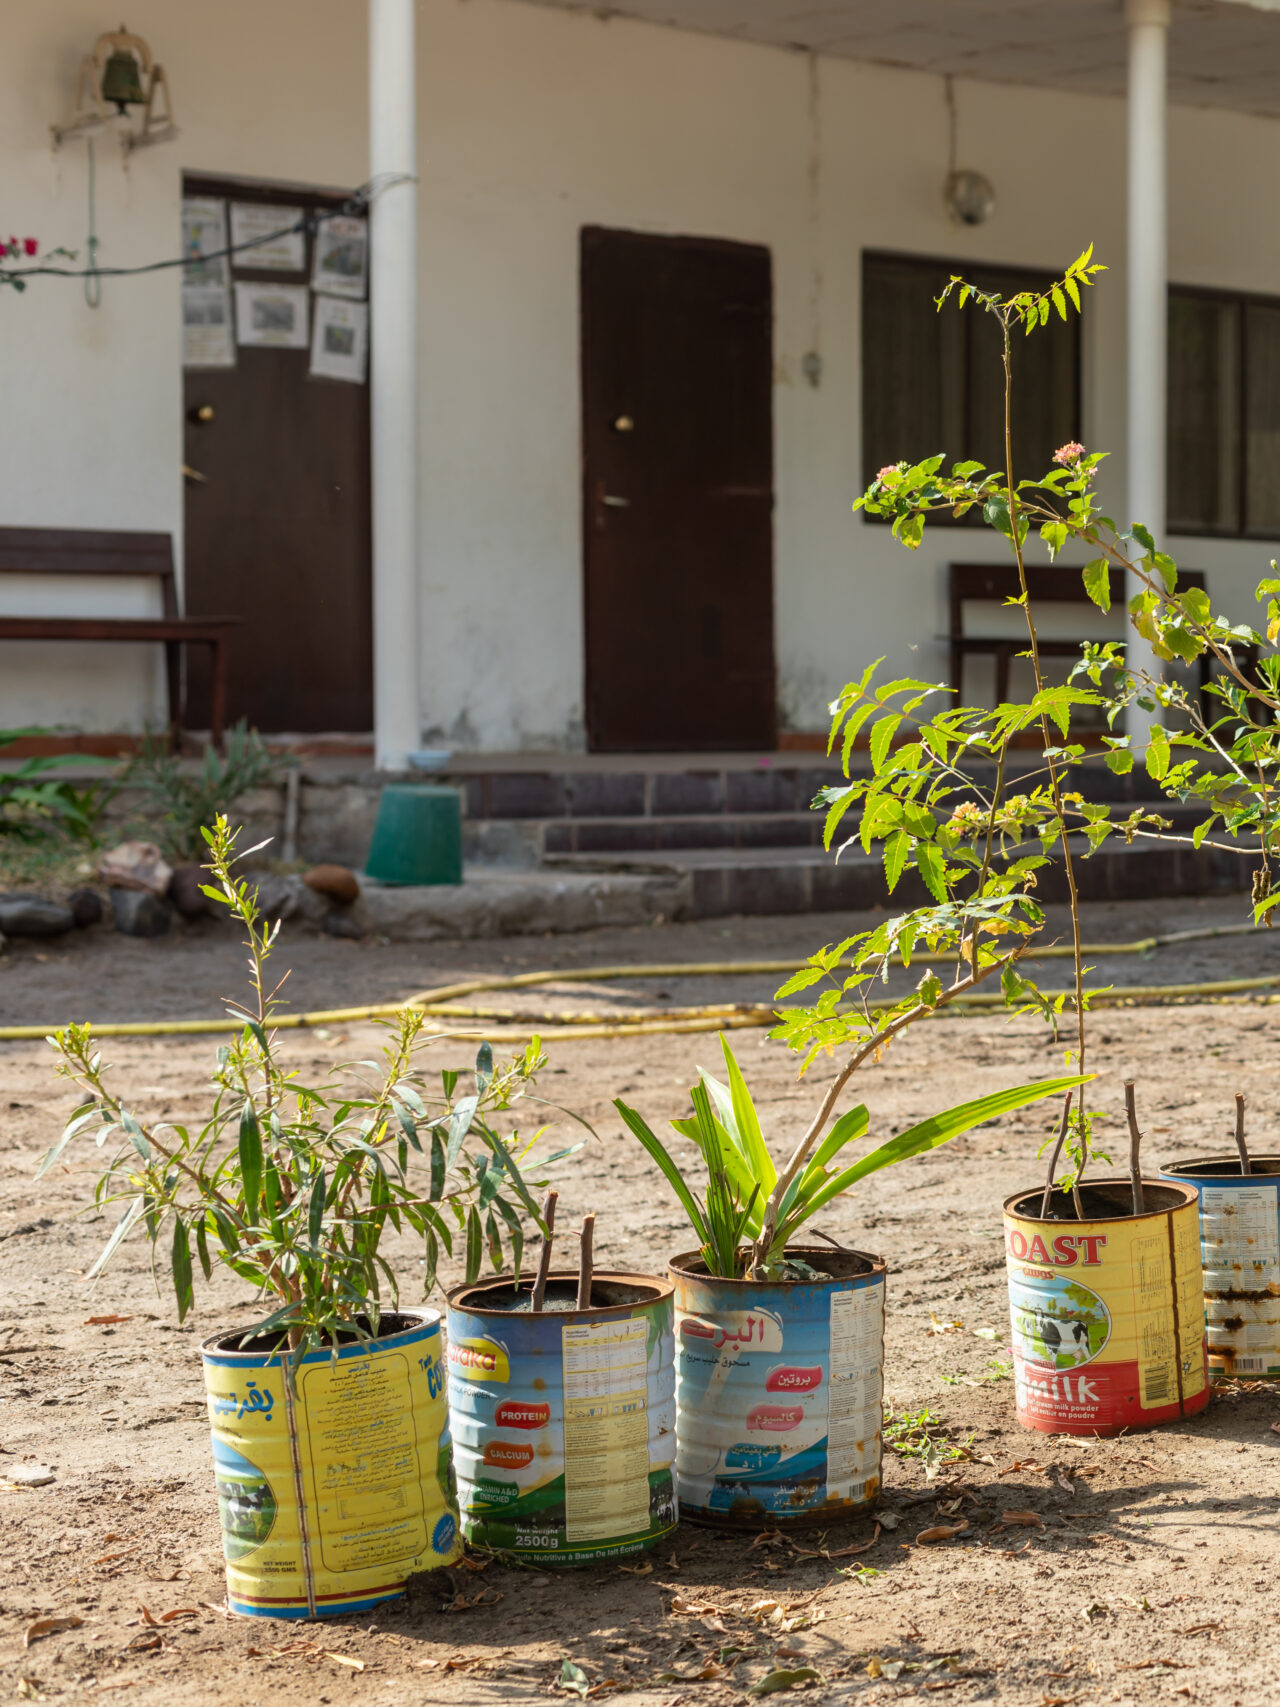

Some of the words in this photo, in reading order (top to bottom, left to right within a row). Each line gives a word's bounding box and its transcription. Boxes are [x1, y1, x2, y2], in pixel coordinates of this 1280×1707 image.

[1005, 1230, 1107, 1267] OAST
[447, 1343, 496, 1371] araka
[721, 1356, 750, 1367] مسحوق
[777, 1374, 811, 1386] بروتين
[1026, 1375, 1100, 1403] milk
[501, 1411, 547, 1421] PROTEIN
[754, 1411, 796, 1425] كالسيوم
[1068, 1411, 1095, 1419] poudre
[490, 1449, 530, 1460] CALCIUM
[480, 1492, 509, 1503] ENRICHED
[533, 1553, 566, 1561] Nutritive
[575, 1552, 594, 1560] Base
[607, 1547, 619, 1555] lait
